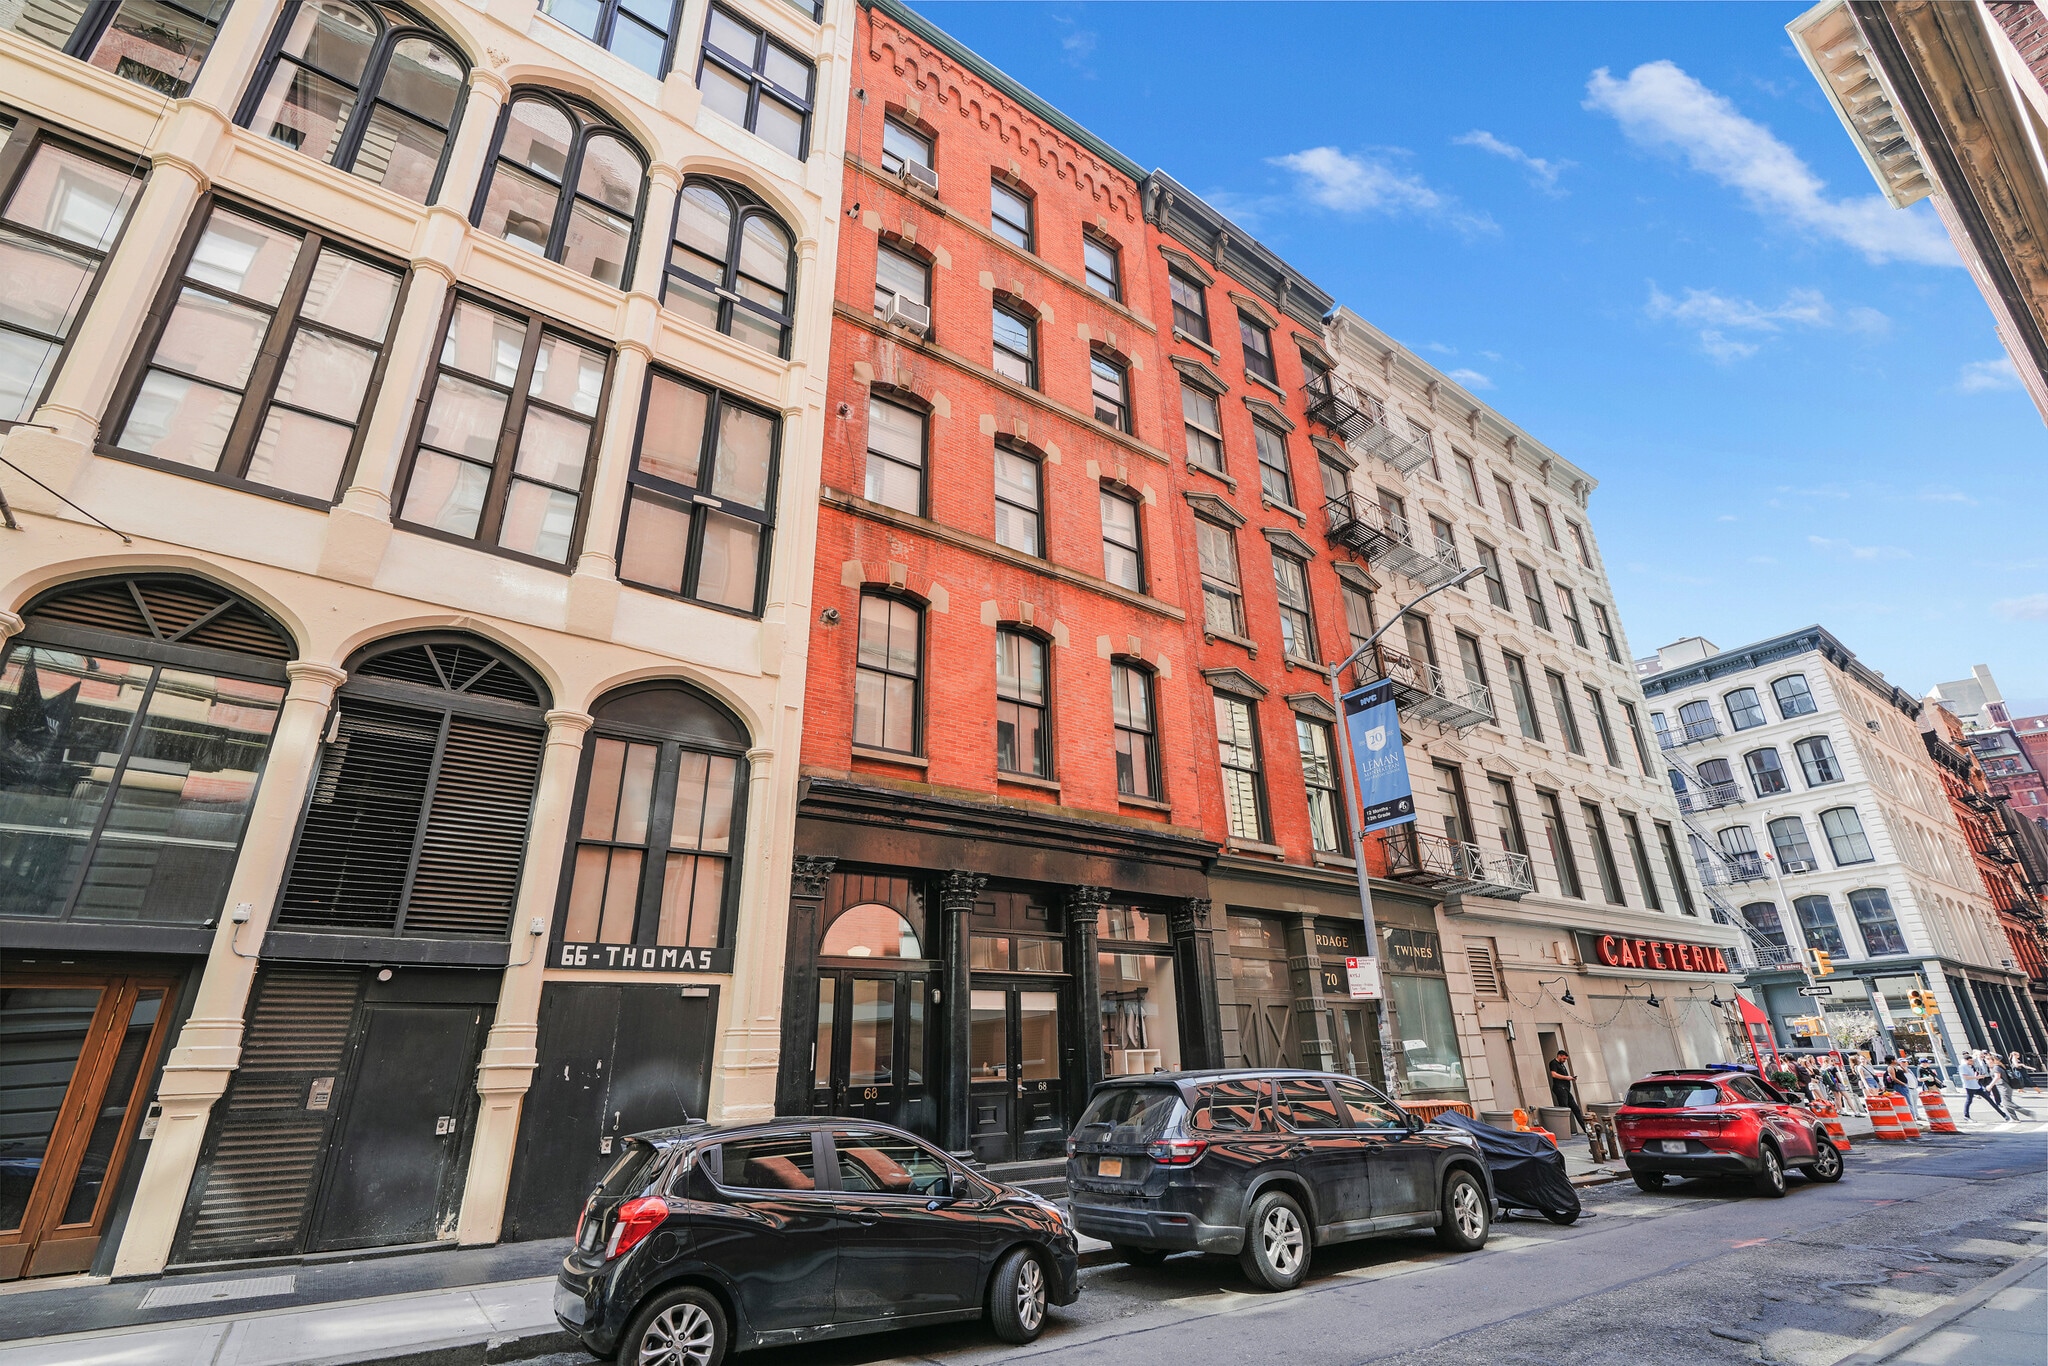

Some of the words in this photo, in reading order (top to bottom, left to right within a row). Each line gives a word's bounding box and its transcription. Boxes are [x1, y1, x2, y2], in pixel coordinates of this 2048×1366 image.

[1360, 694, 1377, 706] NYC
[1370, 732, 1382, 744] 20
[561, 945, 588, 966] 66
[606, 946, 712, 969] THOMAS
[1394, 945, 1433, 958] TWINES
[1598, 935, 1729, 972] CAFETERIA
[1325, 973, 1337, 985] 70
[1038, 1081, 1047, 1091] 68
[864, 1086, 878, 1100] 68
